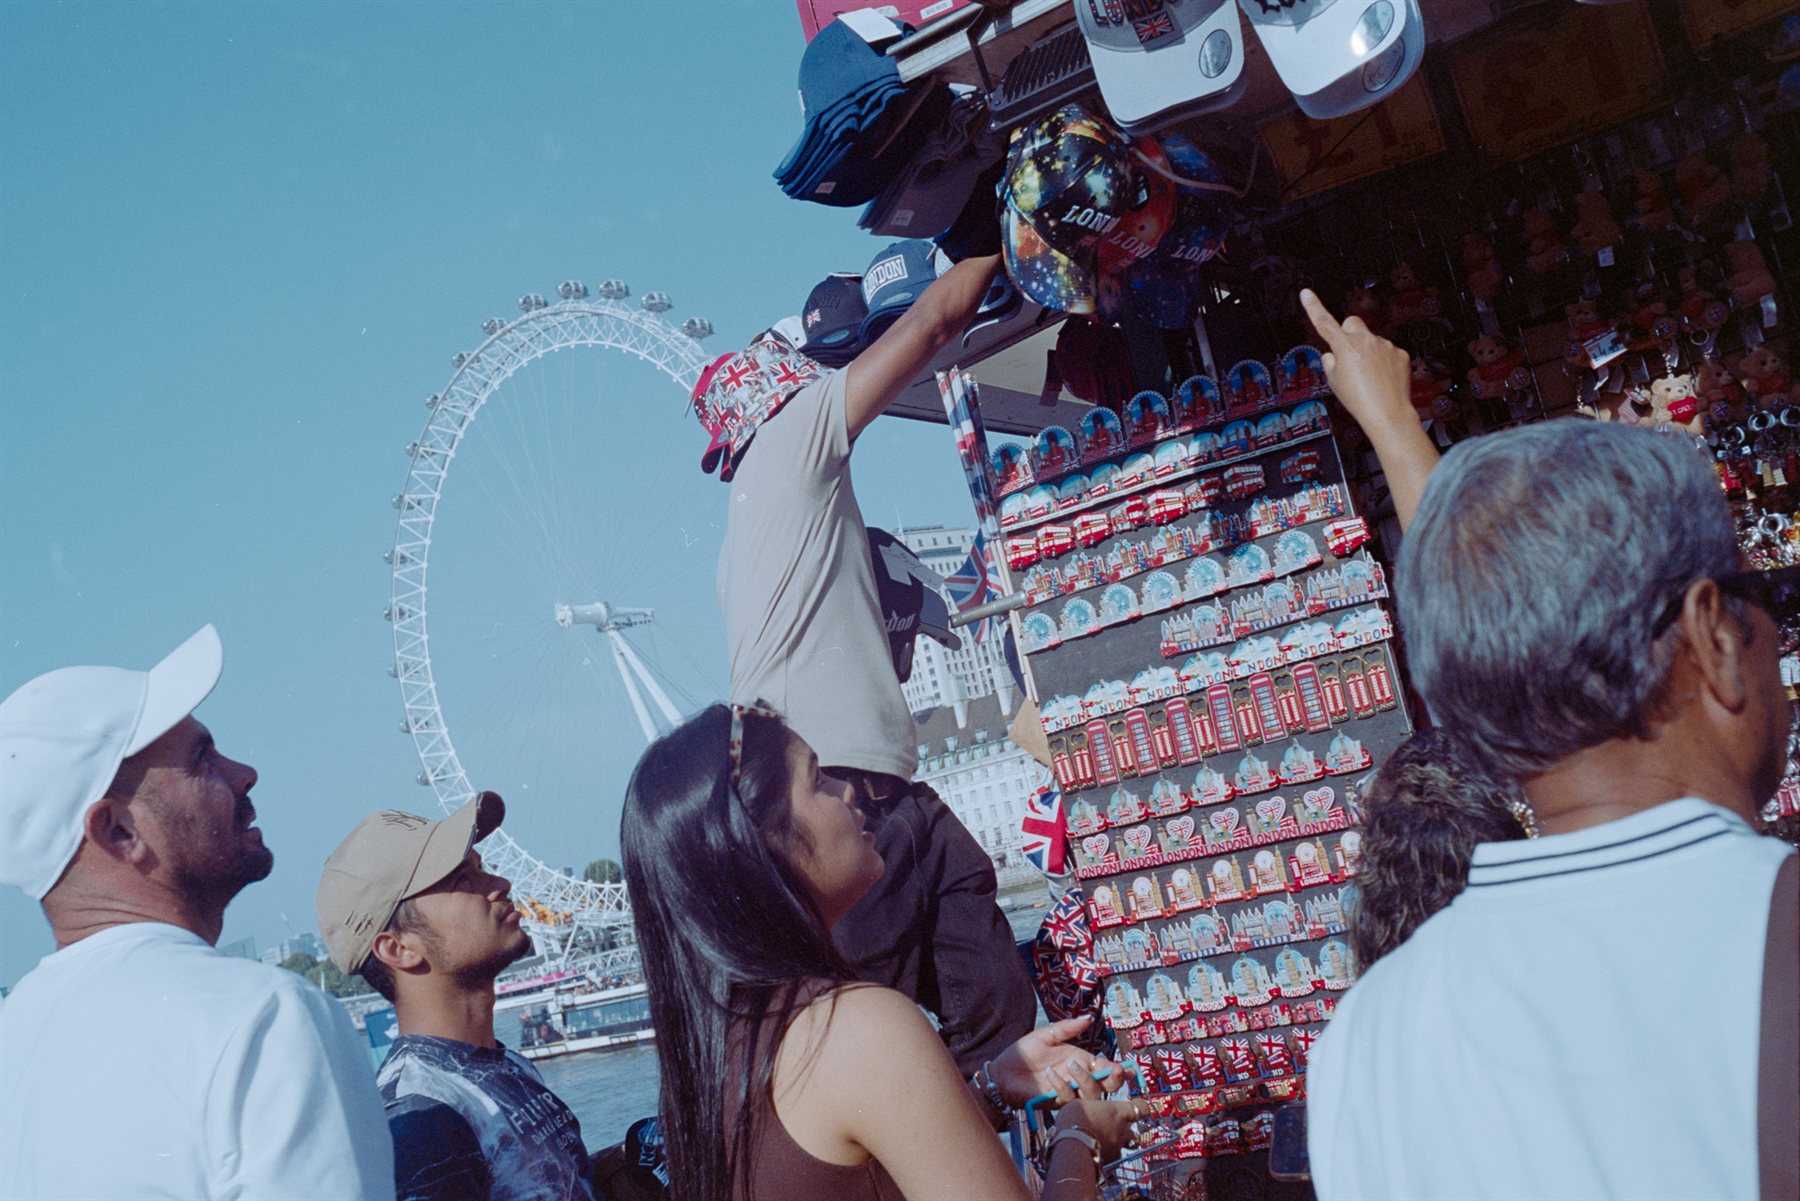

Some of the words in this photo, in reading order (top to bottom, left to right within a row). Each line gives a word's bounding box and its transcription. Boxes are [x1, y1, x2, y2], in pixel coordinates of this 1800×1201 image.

[866, 259, 904, 293] LONDON
[1329, 594, 1366, 608] LONDON
[886, 610, 916, 632] don
[1298, 818, 1347, 835] LONDON
[1252, 827, 1298, 844] LONDON
[1160, 845, 1204, 863] LONDON
[1204, 837, 1252, 855] LONDON
[1075, 863, 1117, 878] LONDON
[1118, 854, 1160, 871] LONDON
[1300, 875, 1330, 886] LONDON
[1254, 935, 1288, 947] LONDON
